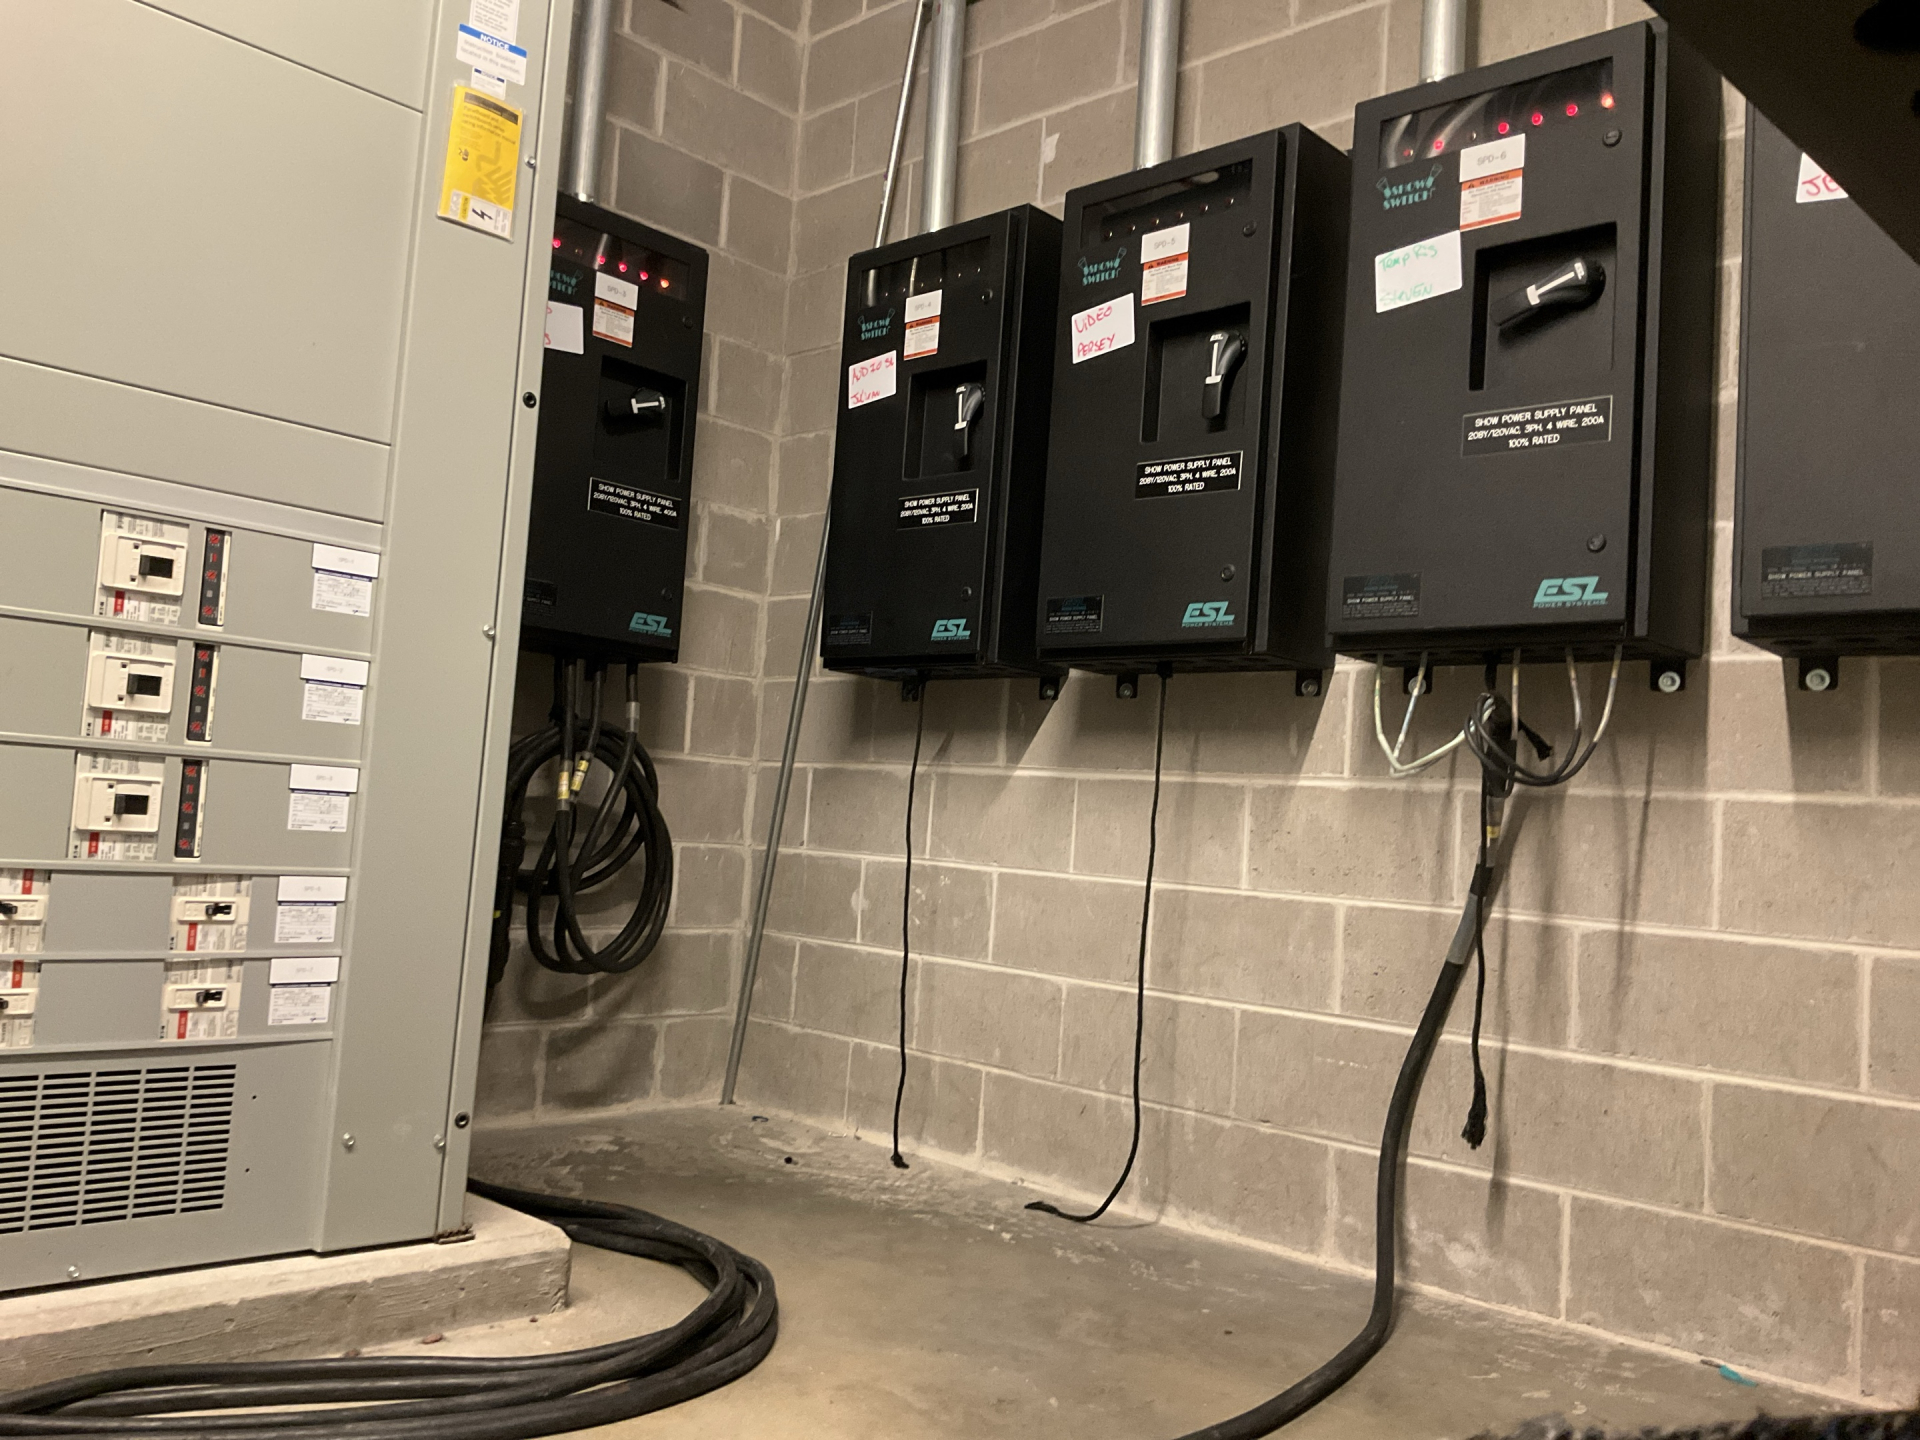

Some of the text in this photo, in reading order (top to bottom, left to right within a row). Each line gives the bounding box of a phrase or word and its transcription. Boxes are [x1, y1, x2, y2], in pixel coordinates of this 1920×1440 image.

[480, 34, 509, 50] NOTICE
[1477, 150, 1507, 166] SPD-6
[1474, 403, 1598, 428] SHOW POWER SUPPLY PANEL
[1546, 421, 1553, 430] 4
[1581, 415, 1605, 427] 200A
[1508, 433, 1560, 448] 100% RATED
[1144, 457, 1232, 475] SHOW POWER SUPPLY PANEL
[1194, 471, 1200, 479] 4
[1219, 467, 1237, 477] 200A
[1167, 481, 1205, 493] 100% RATED
[598, 483, 674, 508] SHOW POWER SUPPLY PANEL
[904, 493, 970, 508] SHOW POWER SUPPLY PANEL
[619, 507, 652, 521] 100% RATED
[663, 509, 677, 517] 400A
[921, 514, 950, 525] 100% RATED
[1534, 575, 1609, 603] ESL
[1182, 601, 1235, 622] ESL
[630, 611, 672, 633] ESL
[931, 618, 971, 636] ESL
